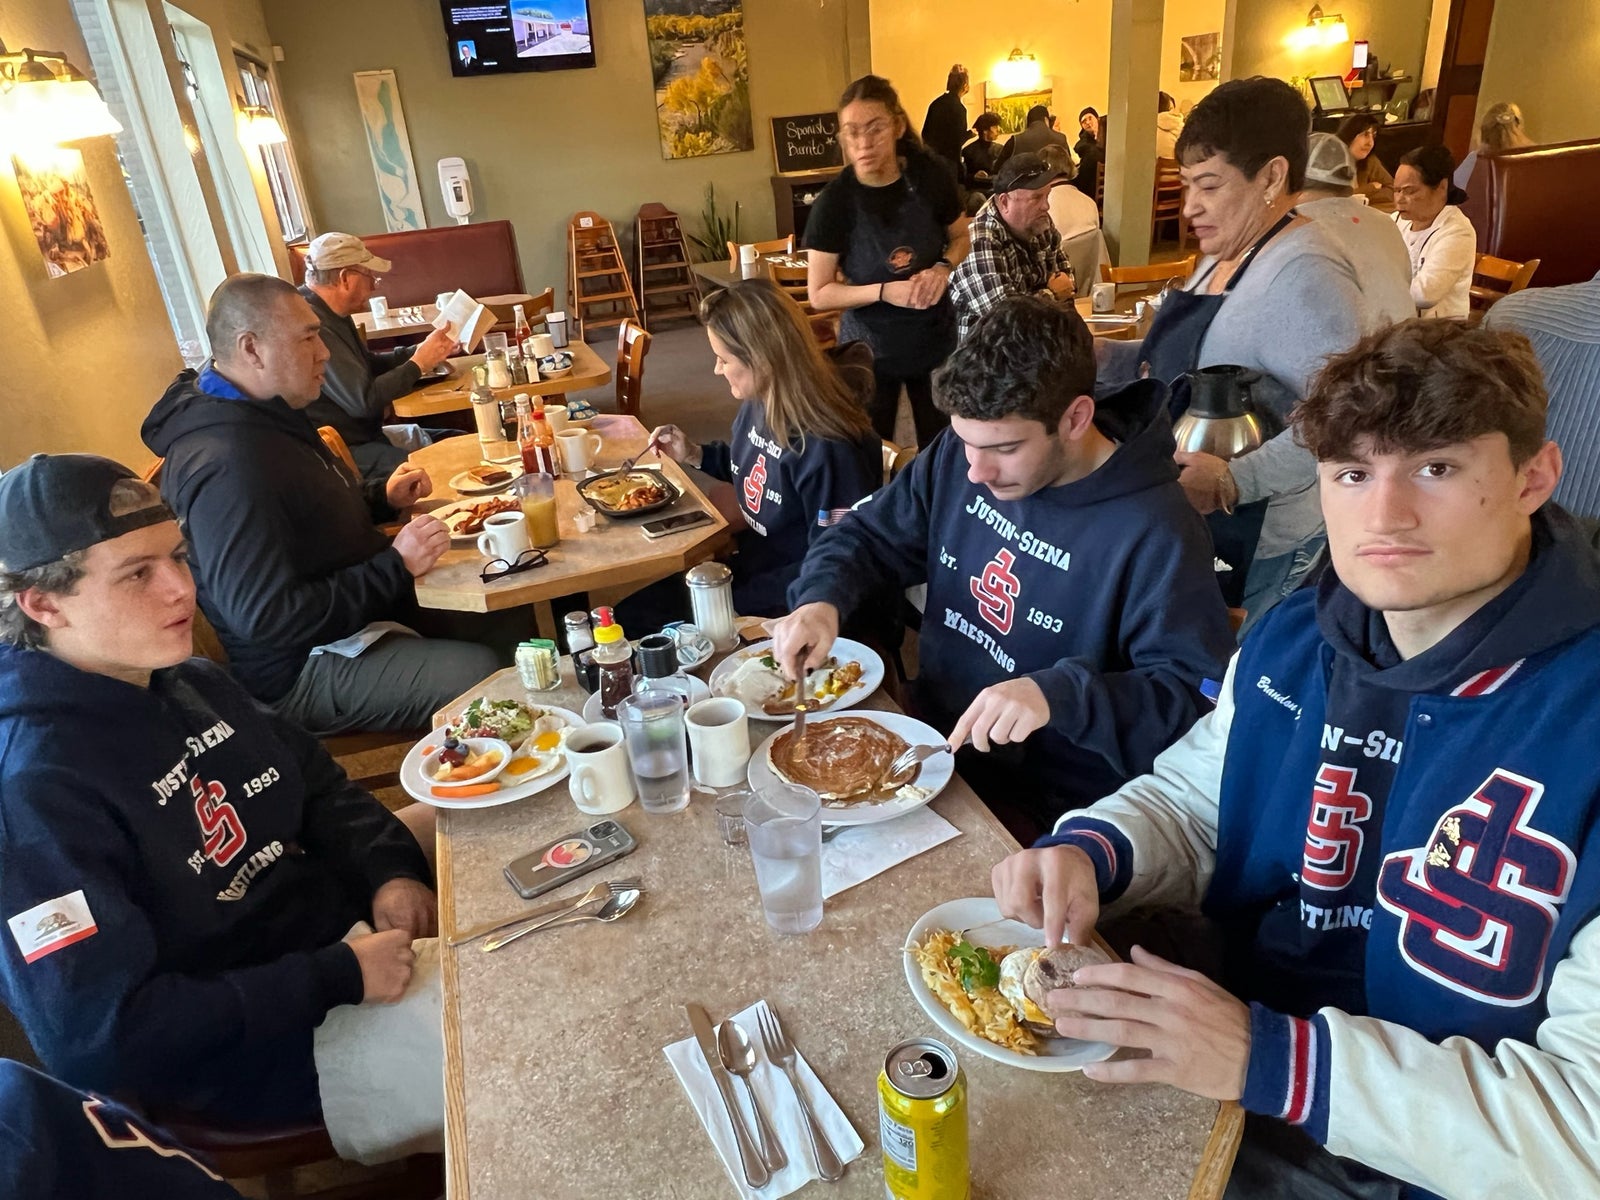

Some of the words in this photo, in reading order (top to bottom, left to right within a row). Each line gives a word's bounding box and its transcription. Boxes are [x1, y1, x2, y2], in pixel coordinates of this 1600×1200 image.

[787, 138, 825, 156] Burrito
[1026, 607, 1063, 633] 1993
[944, 608, 1016, 673] WRESTLING
[243, 767, 281, 797] 1993
